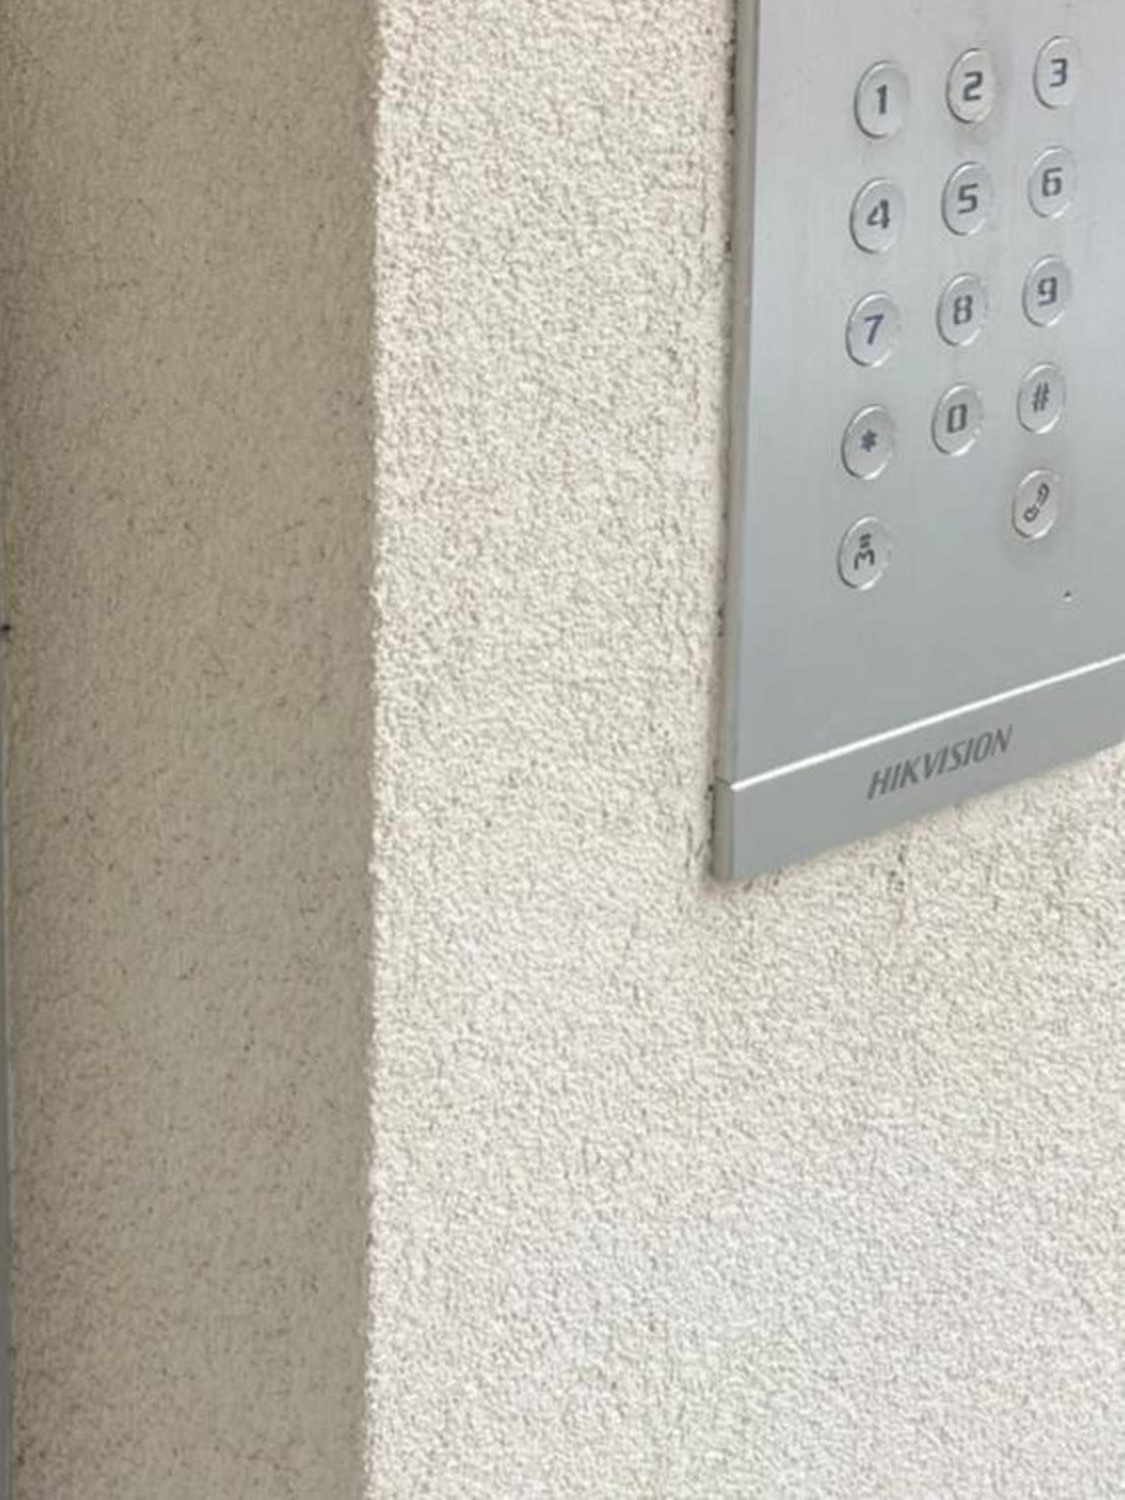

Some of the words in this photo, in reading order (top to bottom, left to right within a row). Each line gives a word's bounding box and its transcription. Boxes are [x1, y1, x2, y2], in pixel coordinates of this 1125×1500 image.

[876, 84, 888, 115] 1
[963, 71, 983, 101] 2
[1049, 58, 1068, 88] 3
[867, 199, 891, 229] 4
[957, 183, 979, 214] 5
[1041, 167, 1063, 197] 6
[863, 313, 884, 345] 7
[953, 295, 973, 325] 8
[1037, 277, 1058, 307] 9
[946, 404, 968, 434] 0
[867, 723, 1013, 800] HIKVISION
